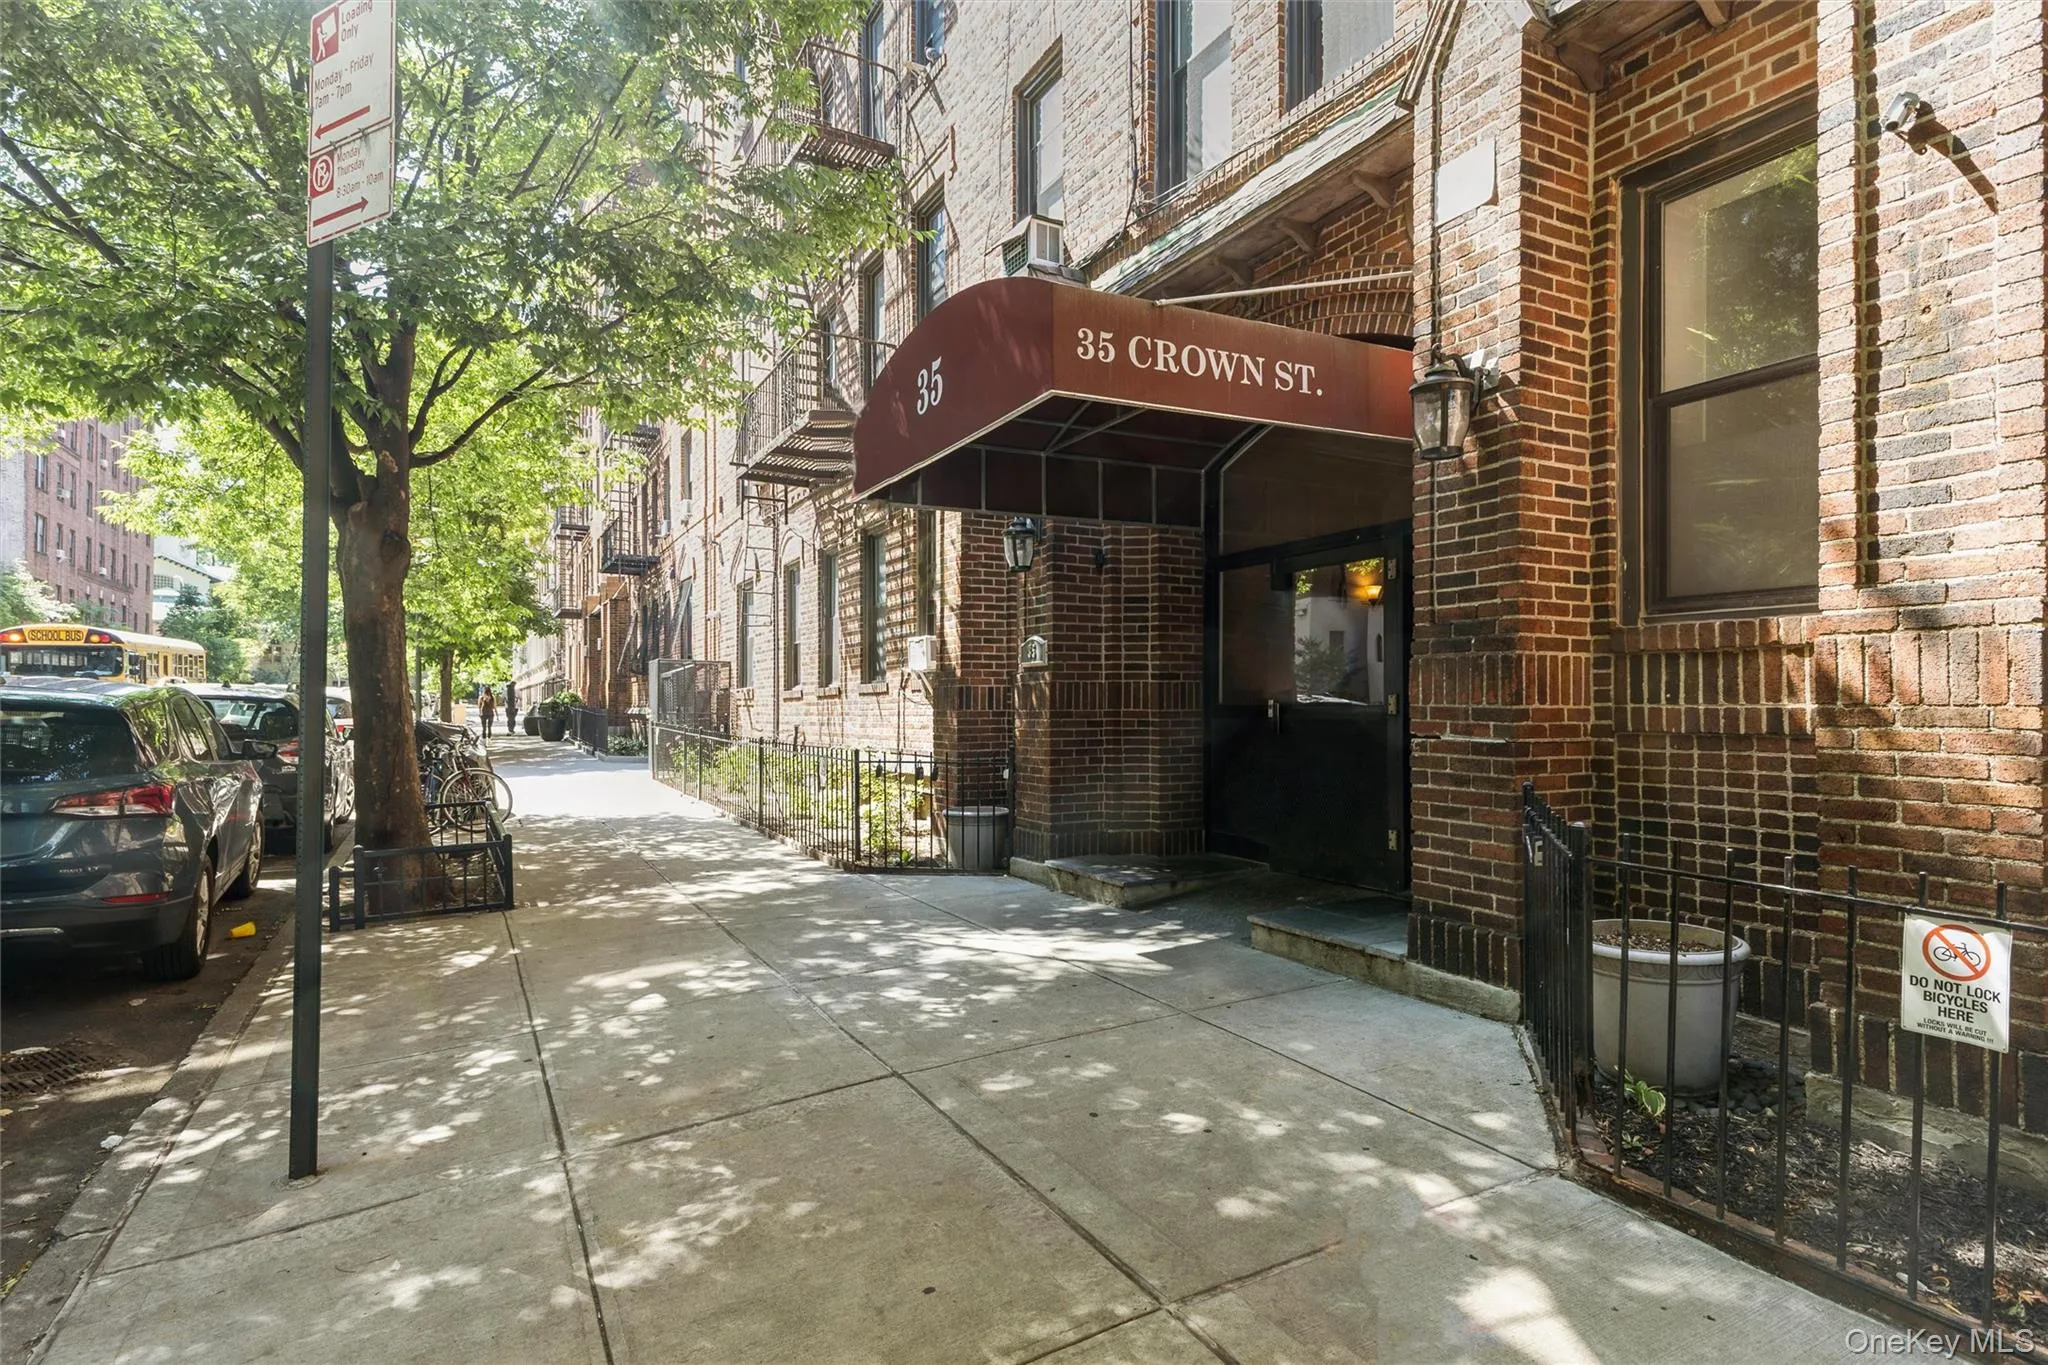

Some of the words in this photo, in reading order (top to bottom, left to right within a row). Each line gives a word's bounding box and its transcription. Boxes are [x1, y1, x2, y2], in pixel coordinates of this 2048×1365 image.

[342, 0, 373, 24] Loading
[341, 24, 359, 41] Only
[315, 71, 342, 93] Monday
[350, 53, 375, 73] Friday
[315, 94, 330, 109] 7am
[336, 82, 352, 98] 7pm
[337, 147, 360, 161] Monday
[337, 159, 365, 176] Thursday
[366, 171, 384, 186] 10am
[1077, 327, 1116, 363] 35
[1128, 335, 1265, 387] CROWN
[1275, 360, 1323, 396] ST.
[917, 356, 943, 415] 35
[30, 630, 64, 641] SCHOOL
[66, 630, 82, 641] BUS
[1910, 975, 1929, 988] DO
[1934, 979, 1962, 994] NOT
[1967, 985, 2001, 1003] LOCK
[1923, 990, 1988, 1013] BICYCLES
[1938, 1006, 1974, 1023] HERE
[1917, 1022, 1946, 1033] WITHOUT
[1955, 1030, 1985, 1042] WARNING
[1923, 1018, 1945, 1027] LOCKS
[1947, 1022, 1963, 1031] WILL
[1974, 1028, 1987, 1036] CUT
